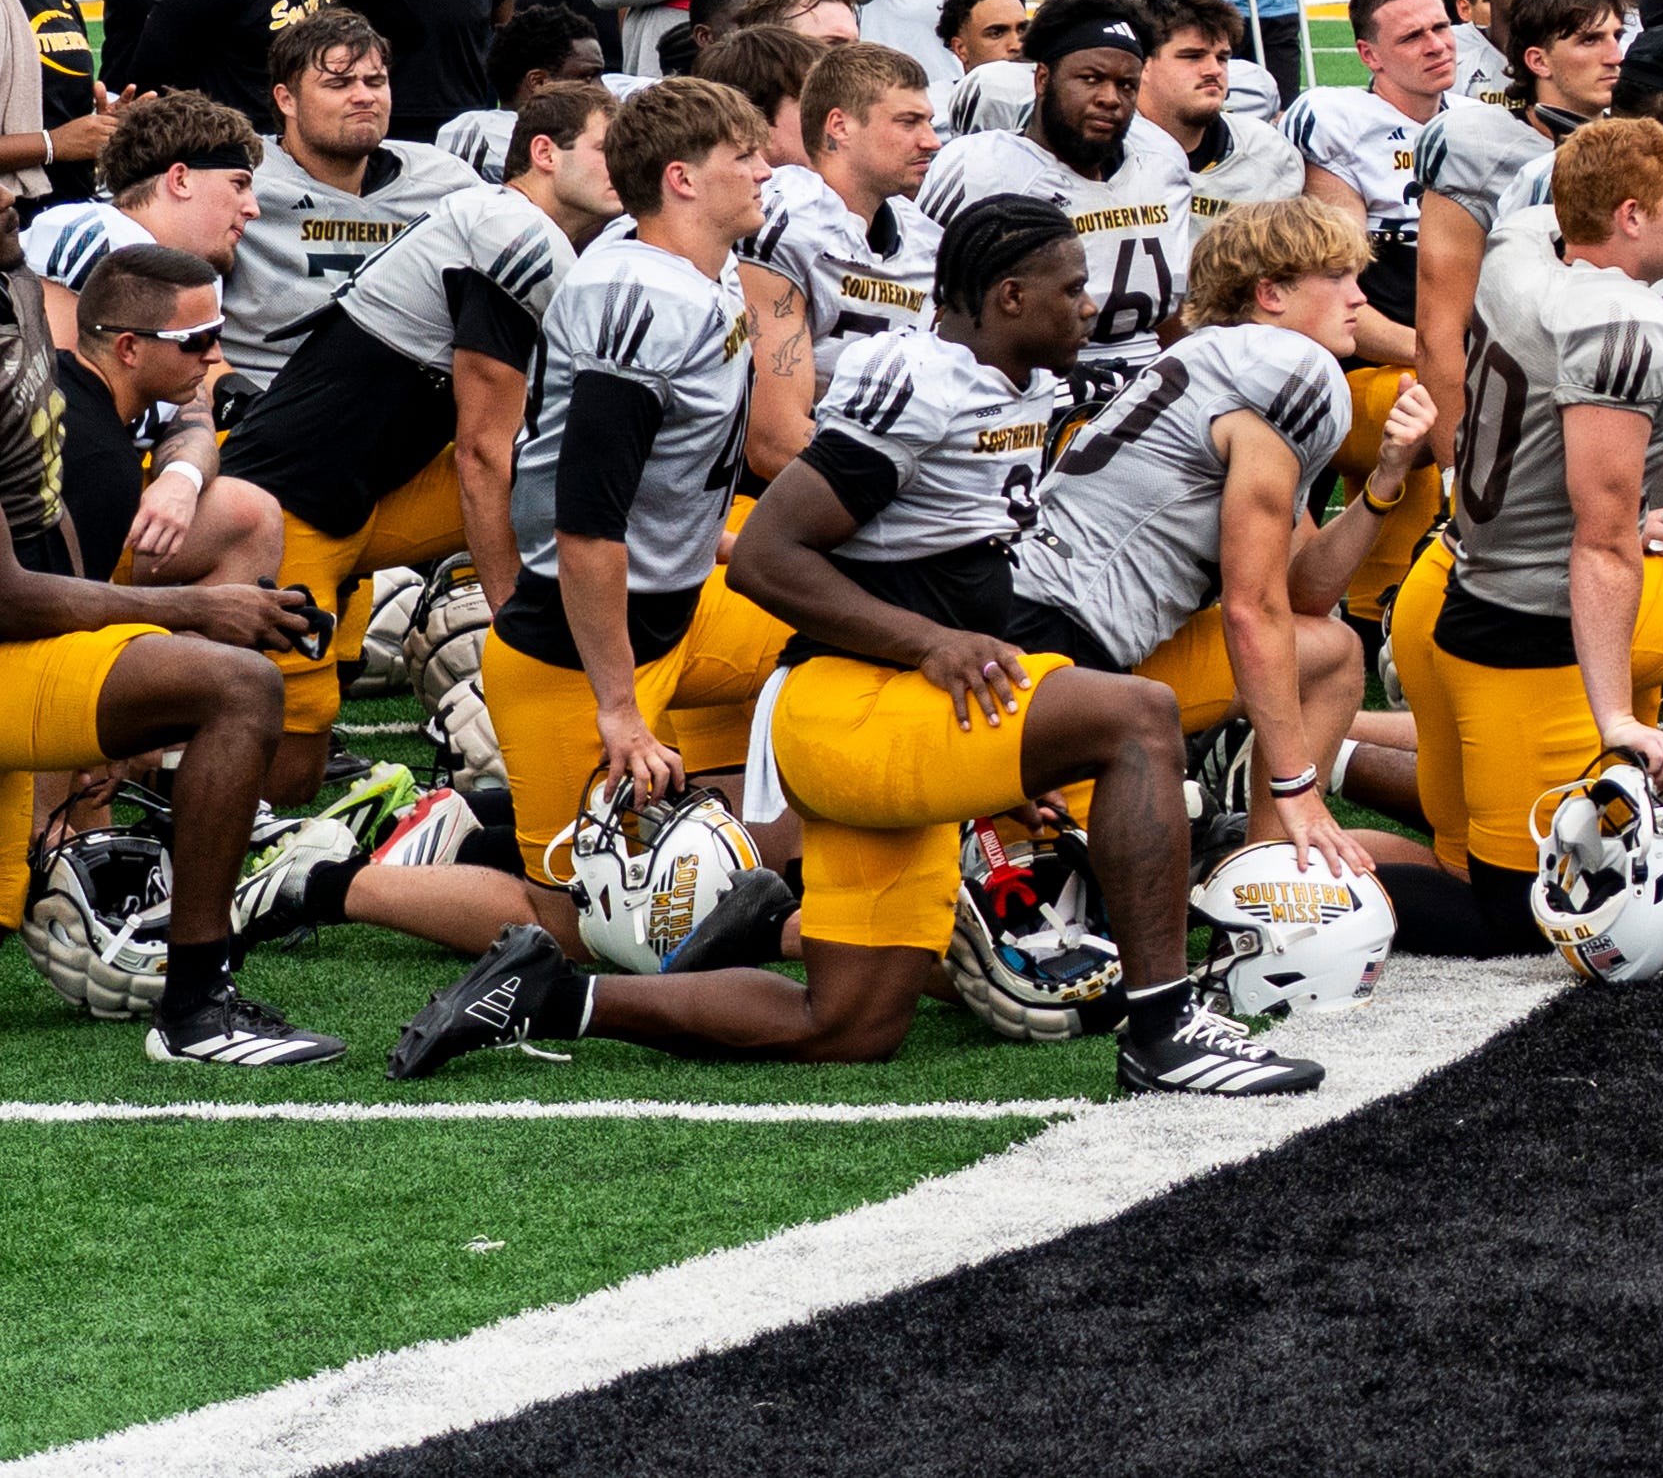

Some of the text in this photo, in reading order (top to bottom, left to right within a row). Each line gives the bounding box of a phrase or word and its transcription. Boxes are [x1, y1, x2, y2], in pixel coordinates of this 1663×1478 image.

[301, 220, 390, 244] SOUTHERN
[1074, 208, 1140, 235] OUTHERN
[1139, 204, 1169, 227] MISS
[840, 275, 909, 307] SOUTHERN
[1094, 237, 1174, 341] 61
[669, 853, 699, 948] SOUTHE
[1232, 881, 1353, 906] SOUTHERN
[649, 892, 672, 937] MISS
[1269, 903, 1322, 925] MISS
